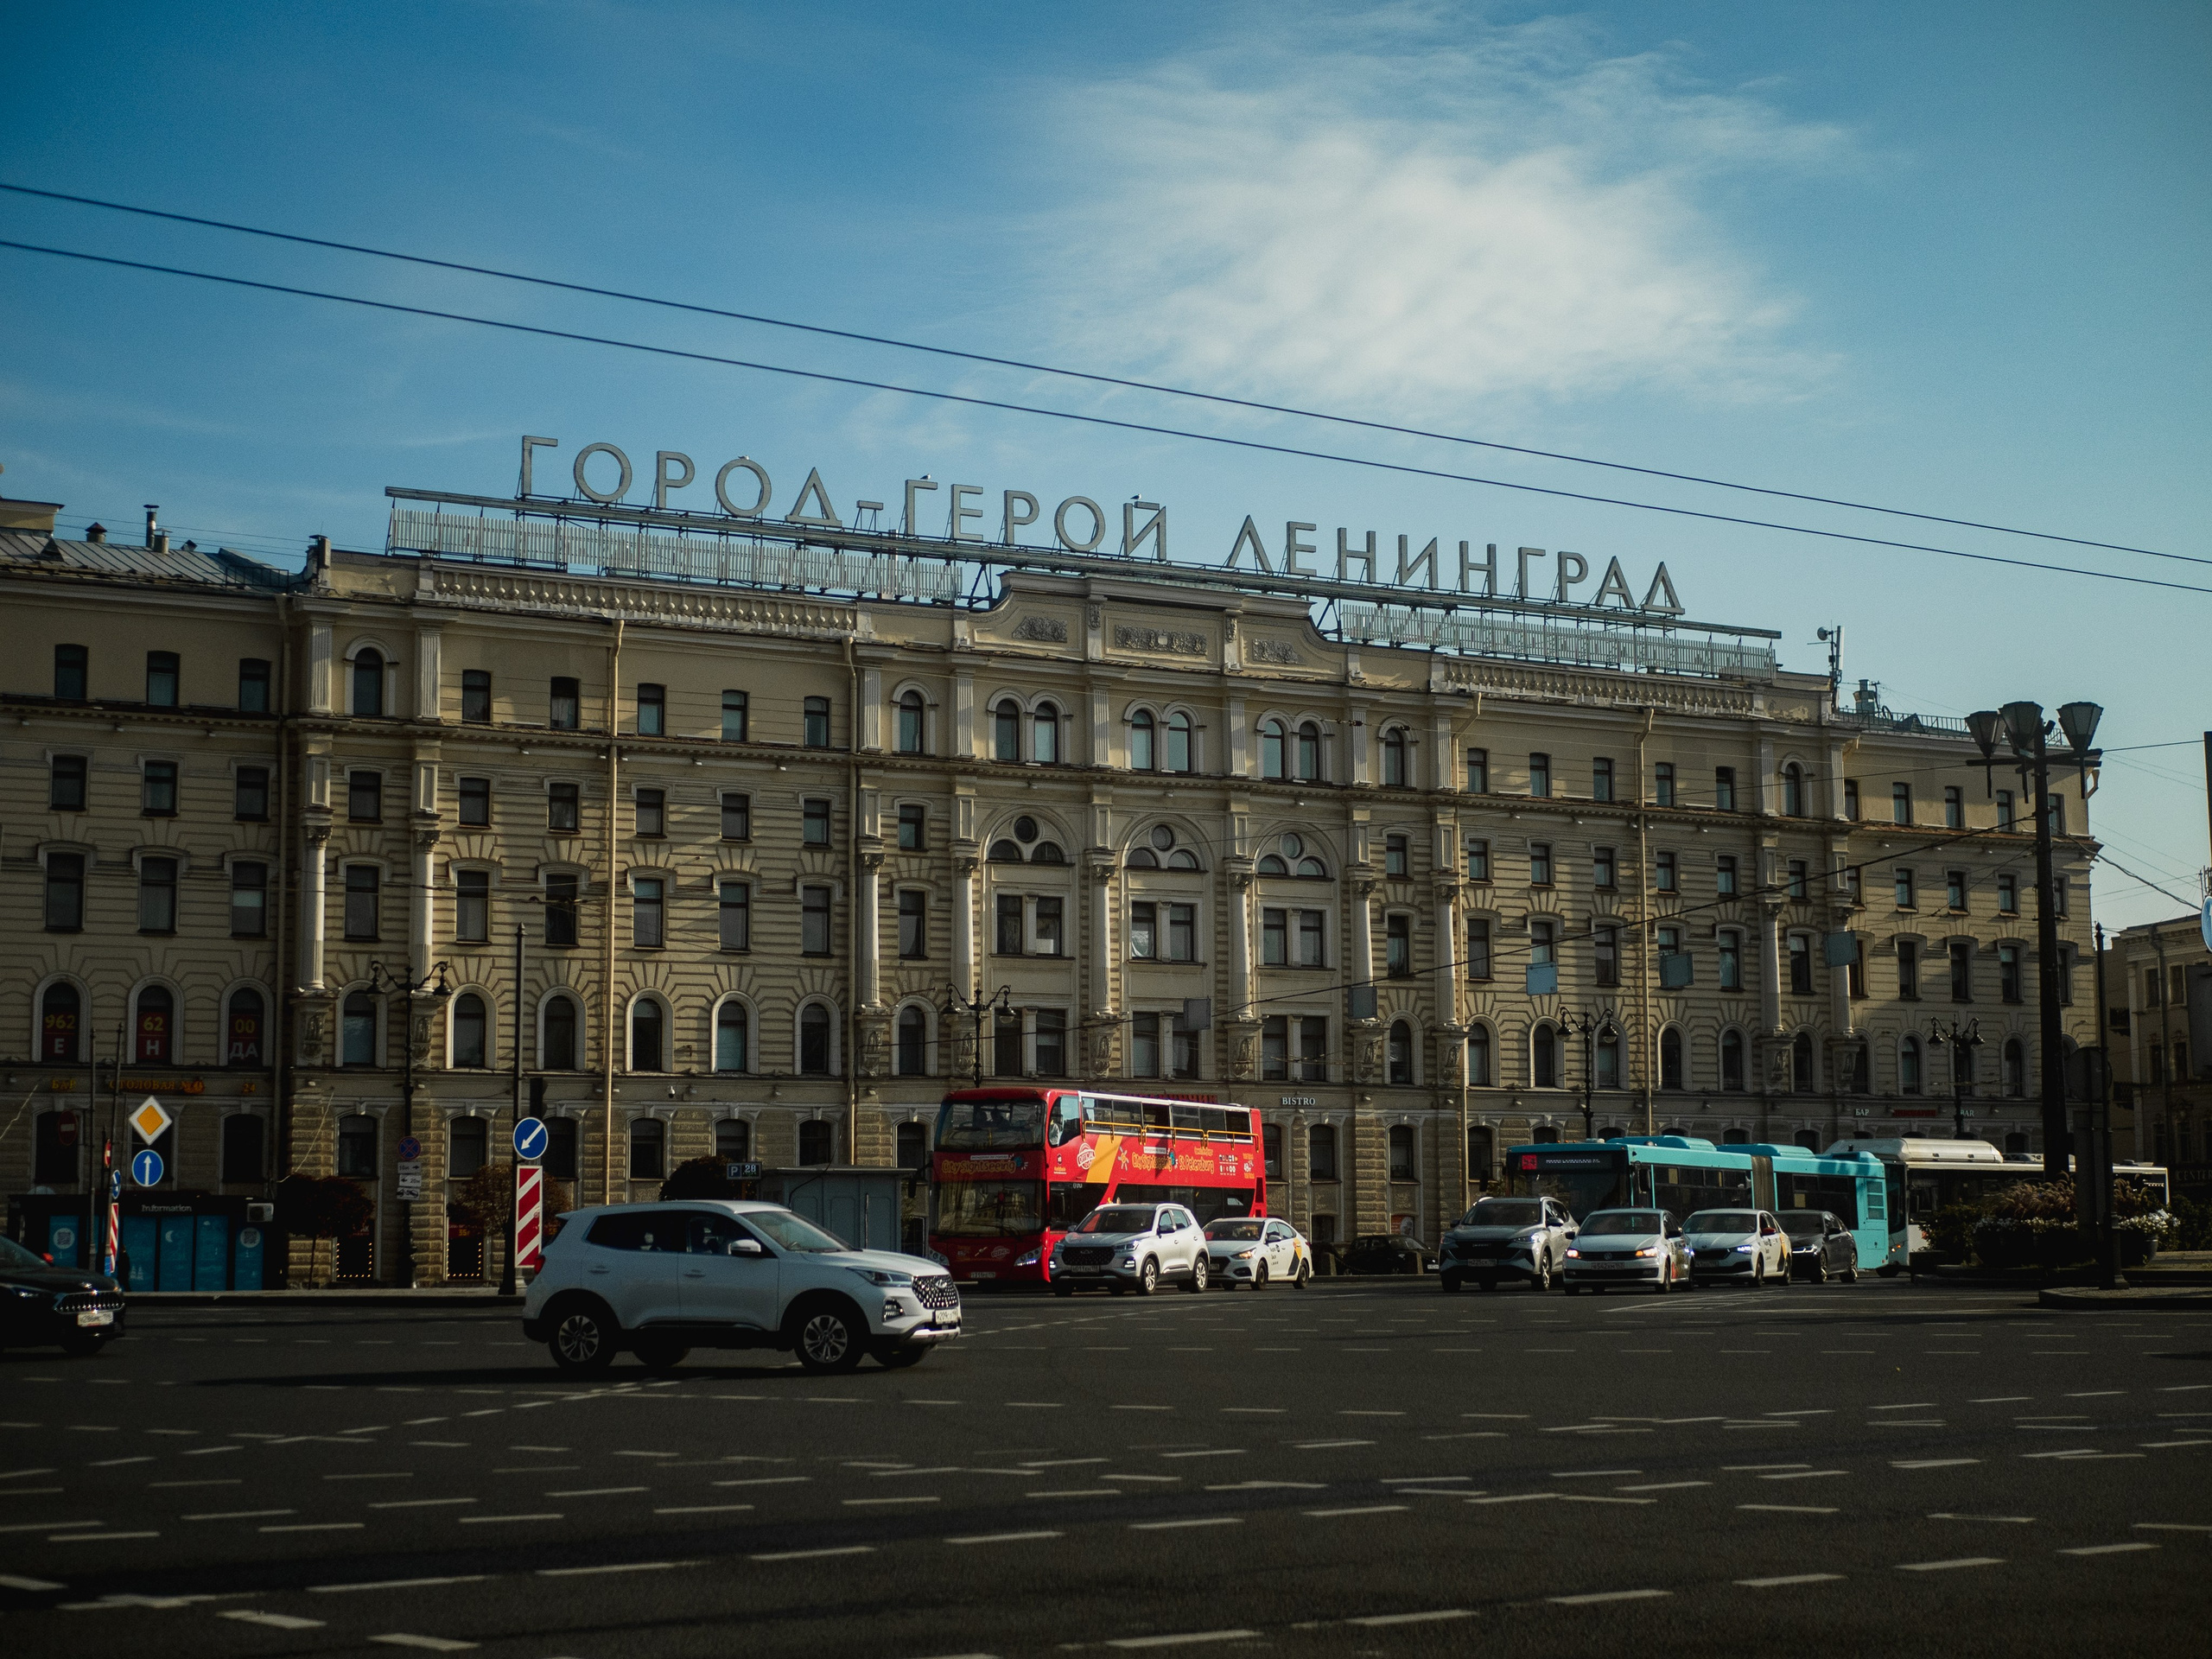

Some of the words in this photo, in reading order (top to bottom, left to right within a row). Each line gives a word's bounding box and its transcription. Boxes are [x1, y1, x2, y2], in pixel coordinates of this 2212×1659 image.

[521, 435, 1166, 561] ГОРОД-ГЕРОЙ
[1227, 514, 1686, 615] ЛЕНИНГРАД
[44, 1014, 76, 1030] 962
[143, 1016, 164, 1032] 62
[234, 1019, 256, 1034] 00
[52, 1078, 76, 1090] БАР
[1281, 1096, 1316, 1106] BISTRO
[141, 1204, 193, 1212] Information
